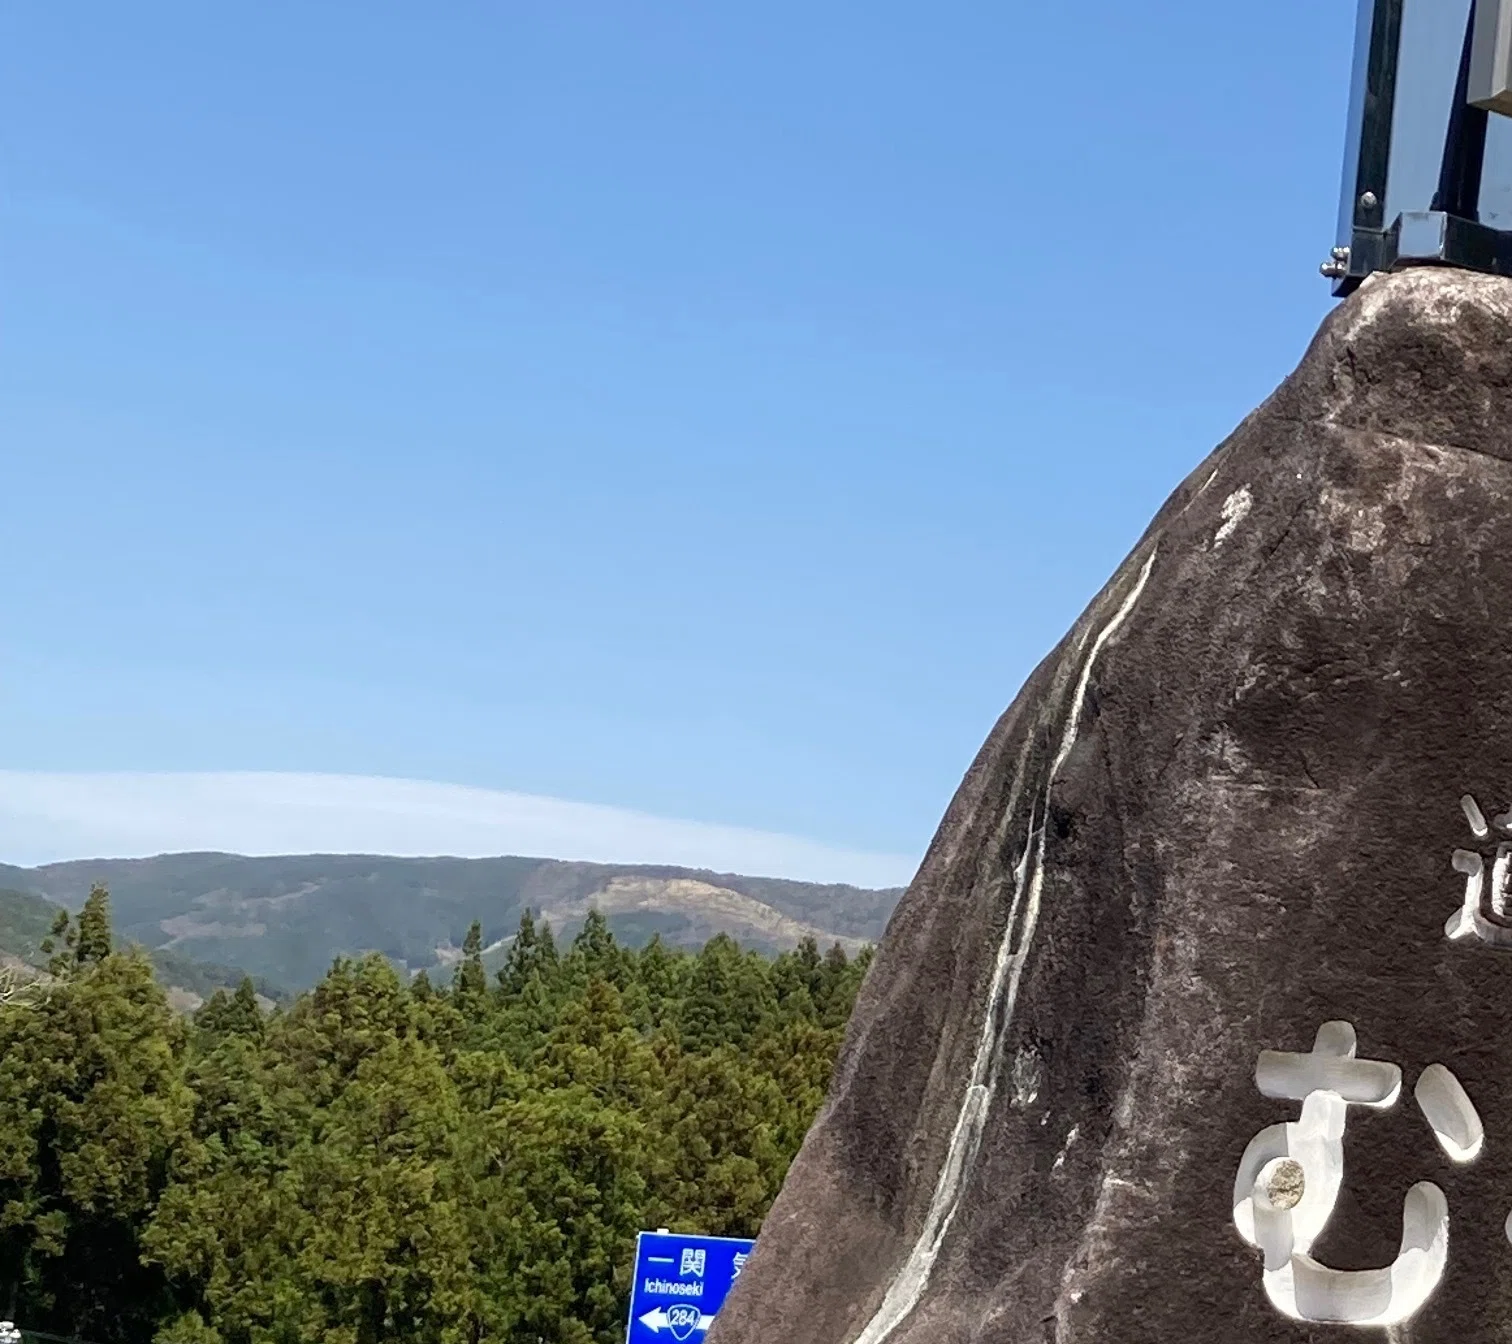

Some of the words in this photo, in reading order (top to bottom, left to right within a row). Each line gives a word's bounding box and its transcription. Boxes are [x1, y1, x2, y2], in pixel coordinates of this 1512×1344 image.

[647, 1248, 706, 1277] 一関
[644, 1277, 704, 1297] Ichinoseki
[670, 1309, 696, 1326] 284
